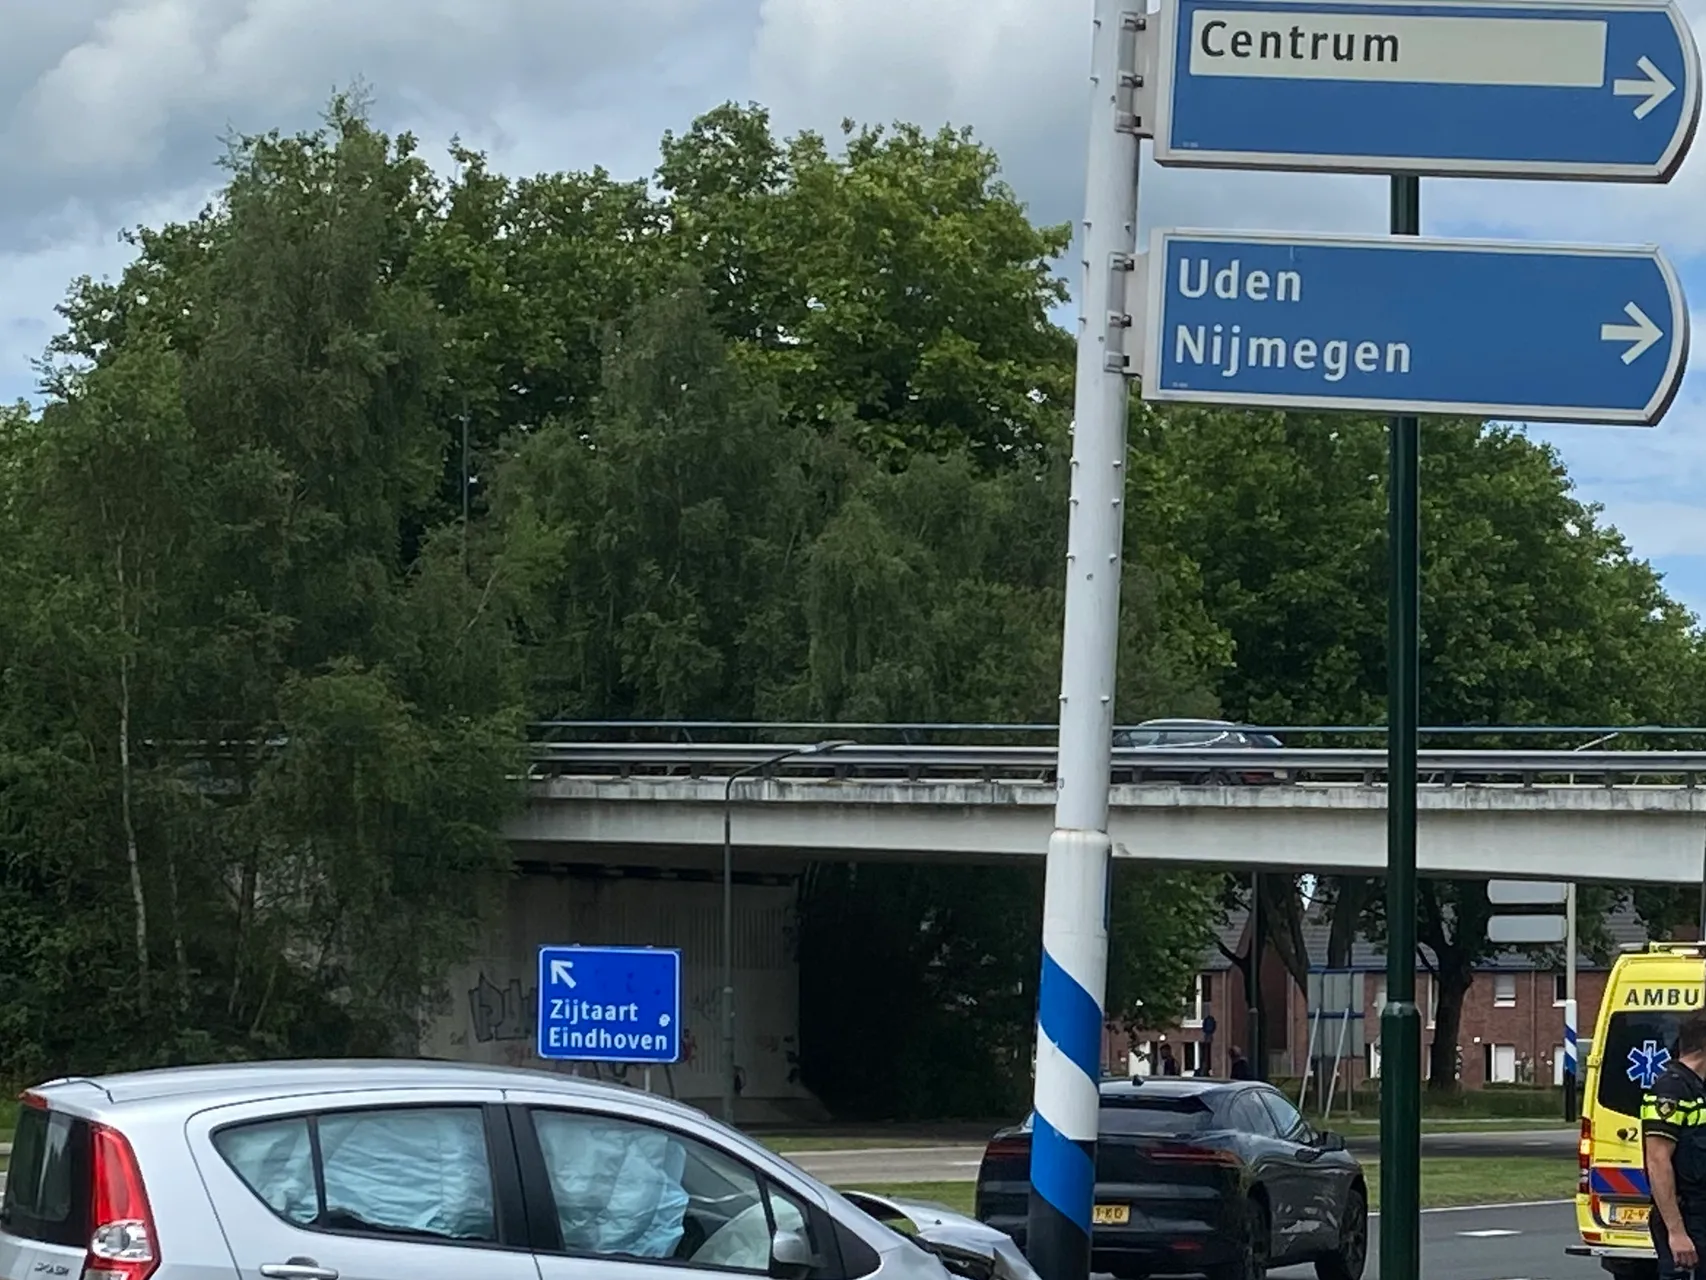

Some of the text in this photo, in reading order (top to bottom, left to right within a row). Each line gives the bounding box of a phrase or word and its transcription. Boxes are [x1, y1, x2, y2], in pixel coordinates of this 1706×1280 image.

[1200, 20, 1399, 63] Centrum
[1177, 258, 1302, 302] Uden
[1175, 325, 1411, 381] Nijmegen
[549, 998, 639, 1025] Zijtaart
[1624, 988, 1700, 1006] AMBU
[549, 1026, 668, 1051] Eindhoven
